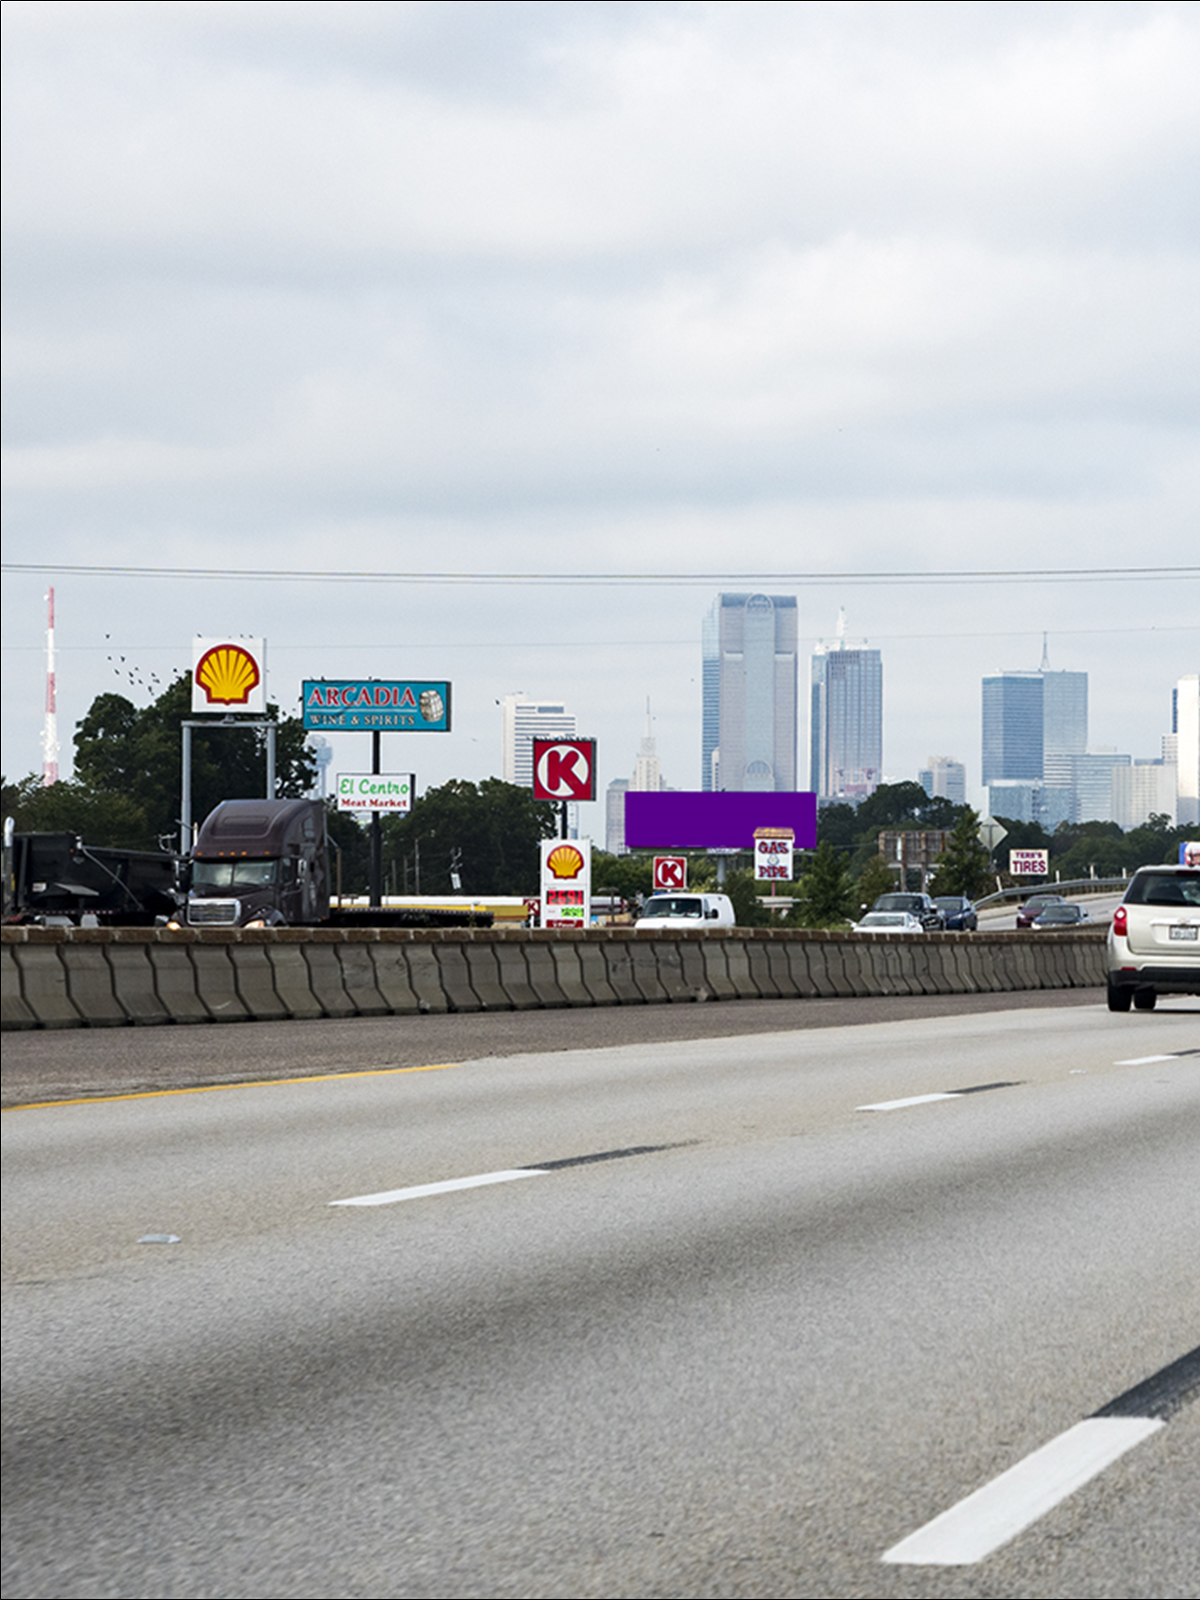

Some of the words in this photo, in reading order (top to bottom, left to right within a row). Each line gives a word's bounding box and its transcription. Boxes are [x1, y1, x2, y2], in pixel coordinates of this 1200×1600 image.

[307, 687, 417, 707] ARCADIA
[309, 715, 347, 725] WINE
[350, 715, 360, 725] &
[364, 715, 415, 725] SPIRITS
[546, 748, 585, 795] K
[339, 778, 354, 795] El
[358, 778, 410, 795] Centro
[341, 799, 367, 807] Meat
[369, 799, 407, 807] Market
[758, 841, 789, 854] GAS
[661, 862, 681, 884] K
[758, 865, 788, 878] PIPE
[1012, 860, 1046, 873] TIRES
